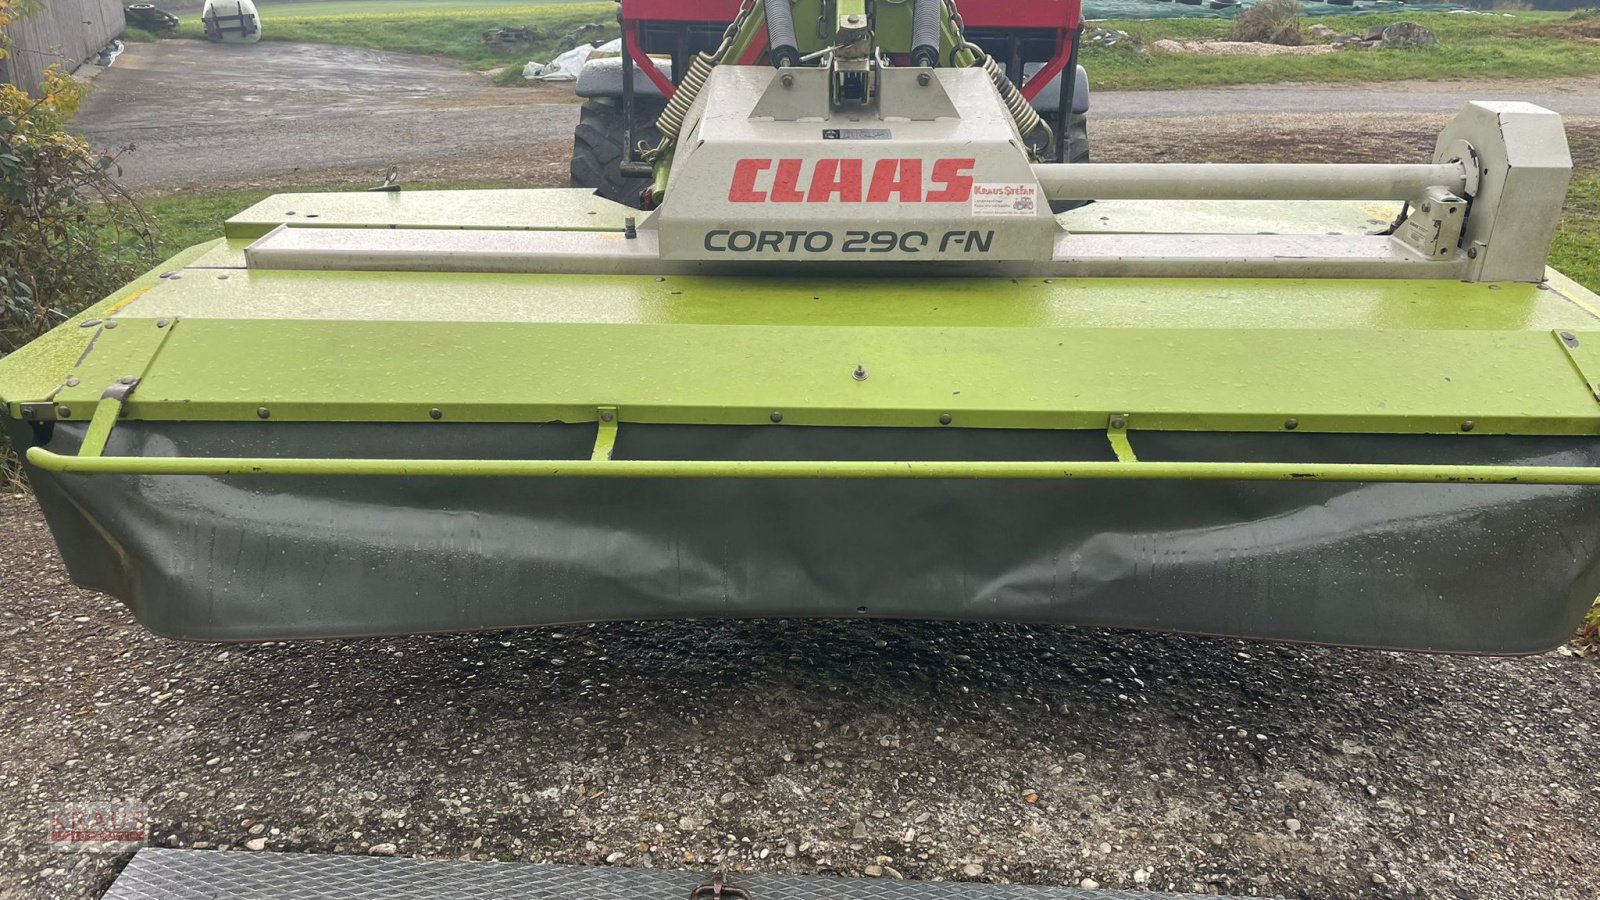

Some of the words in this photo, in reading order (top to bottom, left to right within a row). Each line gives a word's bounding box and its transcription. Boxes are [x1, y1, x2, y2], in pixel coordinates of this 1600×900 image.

[728, 158, 976, 202] CLAAS
[704, 230, 833, 252] CORTO
[841, 230, 928, 253] 290
[938, 230, 995, 253] FN
